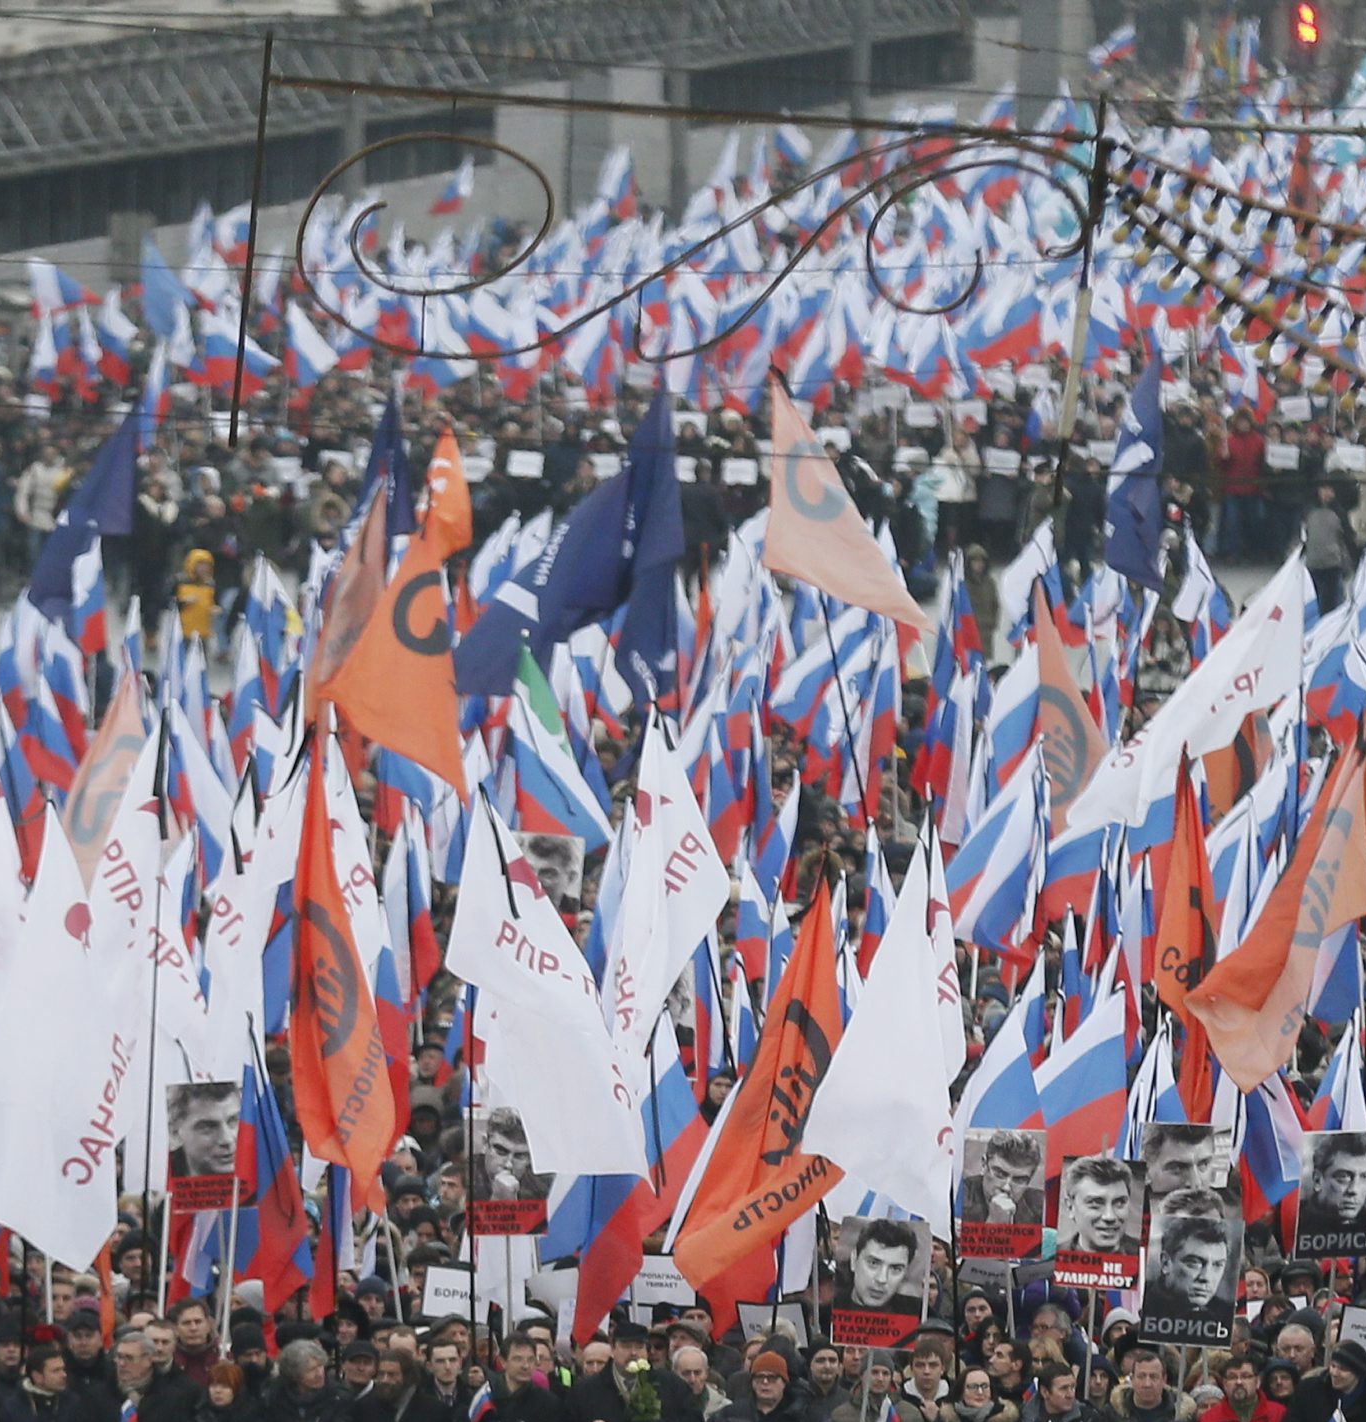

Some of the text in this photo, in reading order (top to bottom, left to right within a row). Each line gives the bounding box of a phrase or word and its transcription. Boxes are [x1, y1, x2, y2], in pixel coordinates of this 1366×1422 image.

[1102, 1262, 1123, 1275] НЕ
[1054, 1271, 1134, 1288] УМИРАЮТ
[840, 1326, 900, 1337] КАЖДОГО
[1143, 1316, 1229, 1339] БОРИСЬ
